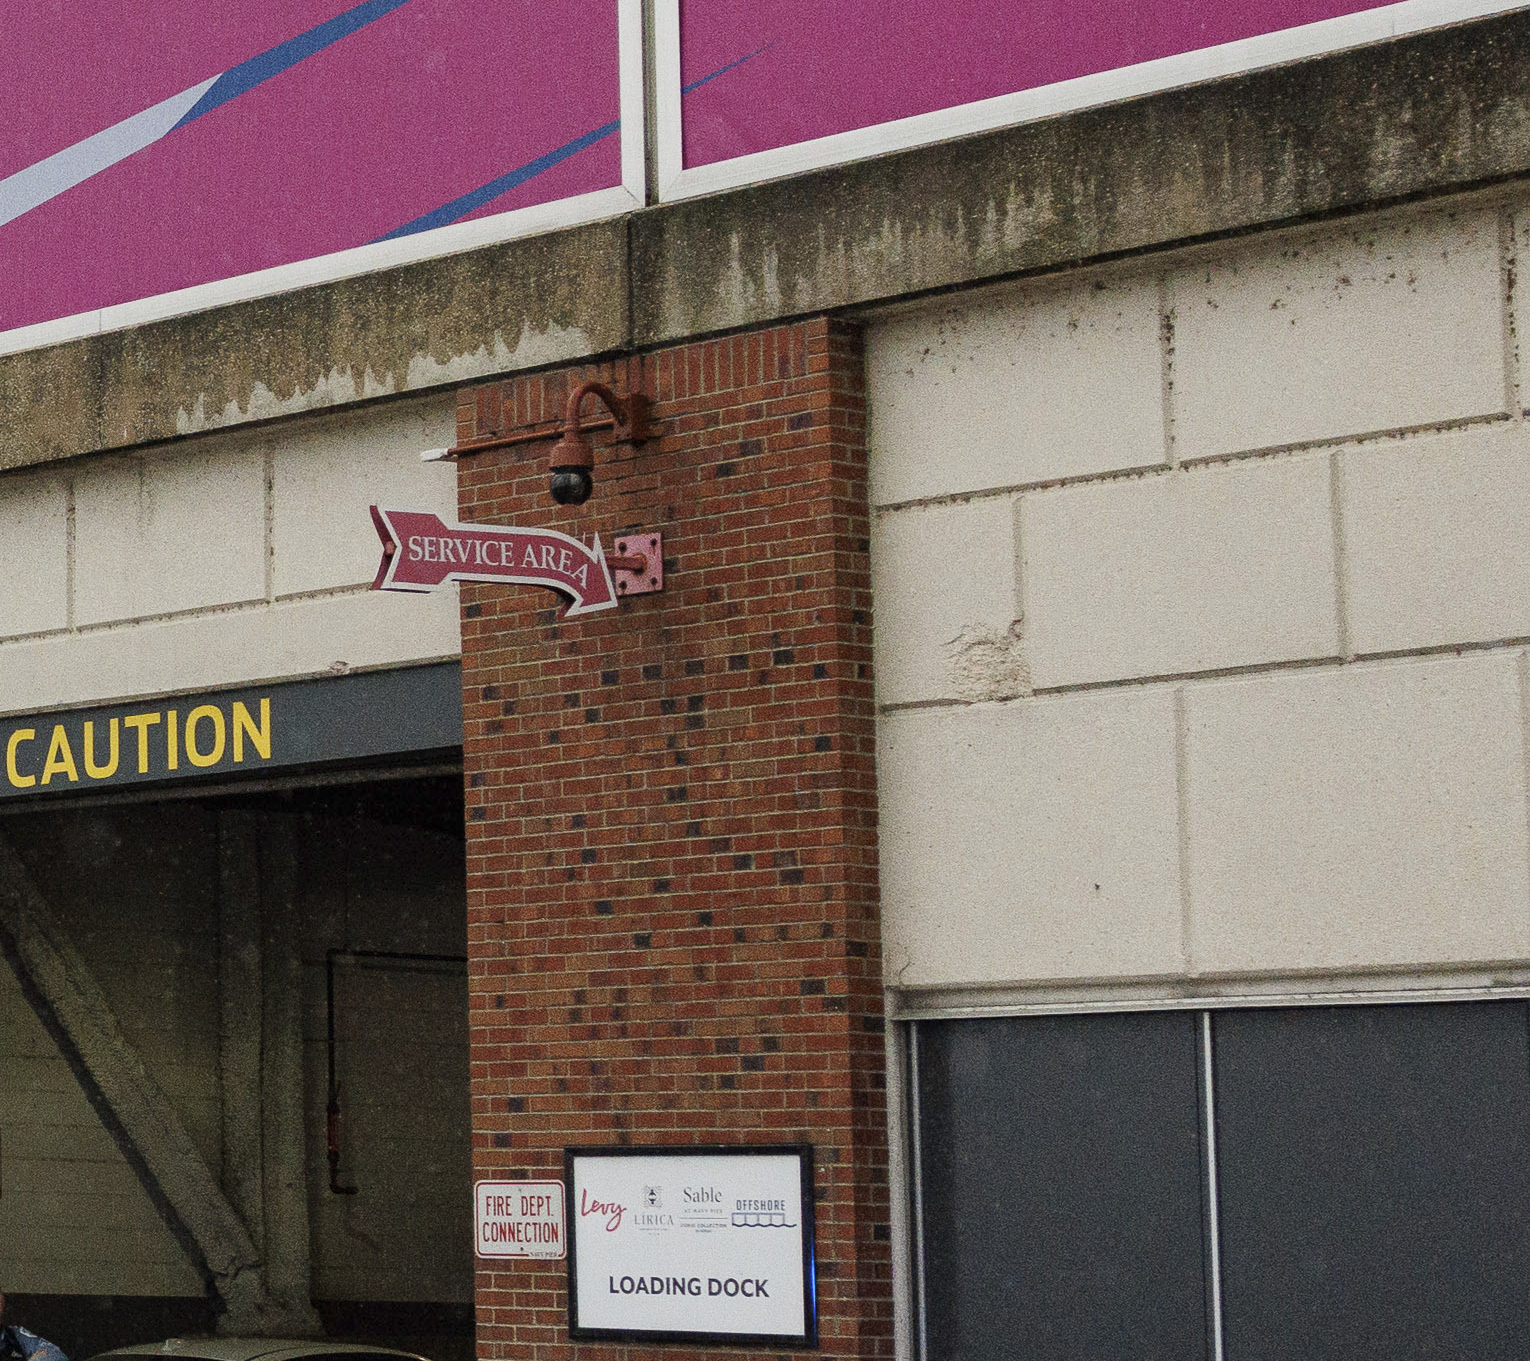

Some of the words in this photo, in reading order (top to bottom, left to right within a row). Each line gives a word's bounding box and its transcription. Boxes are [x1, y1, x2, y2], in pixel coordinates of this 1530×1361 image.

[409, 536, 514, 566] SERVICE
[522, 543, 588, 588] AREA
[6, 698, 273, 789] CAUTION
[485, 1195, 512, 1216] FIRE
[520, 1195, 554, 1217] DEPT.
[683, 1187, 723, 1204] Sable
[736, 1199, 786, 1211] OFFSHORE
[581, 1188, 628, 1232] Levy
[482, 1222, 559, 1243] CONNECTION
[609, 1276, 702, 1297] LOADING
[708, 1278, 770, 1298] DOCK
